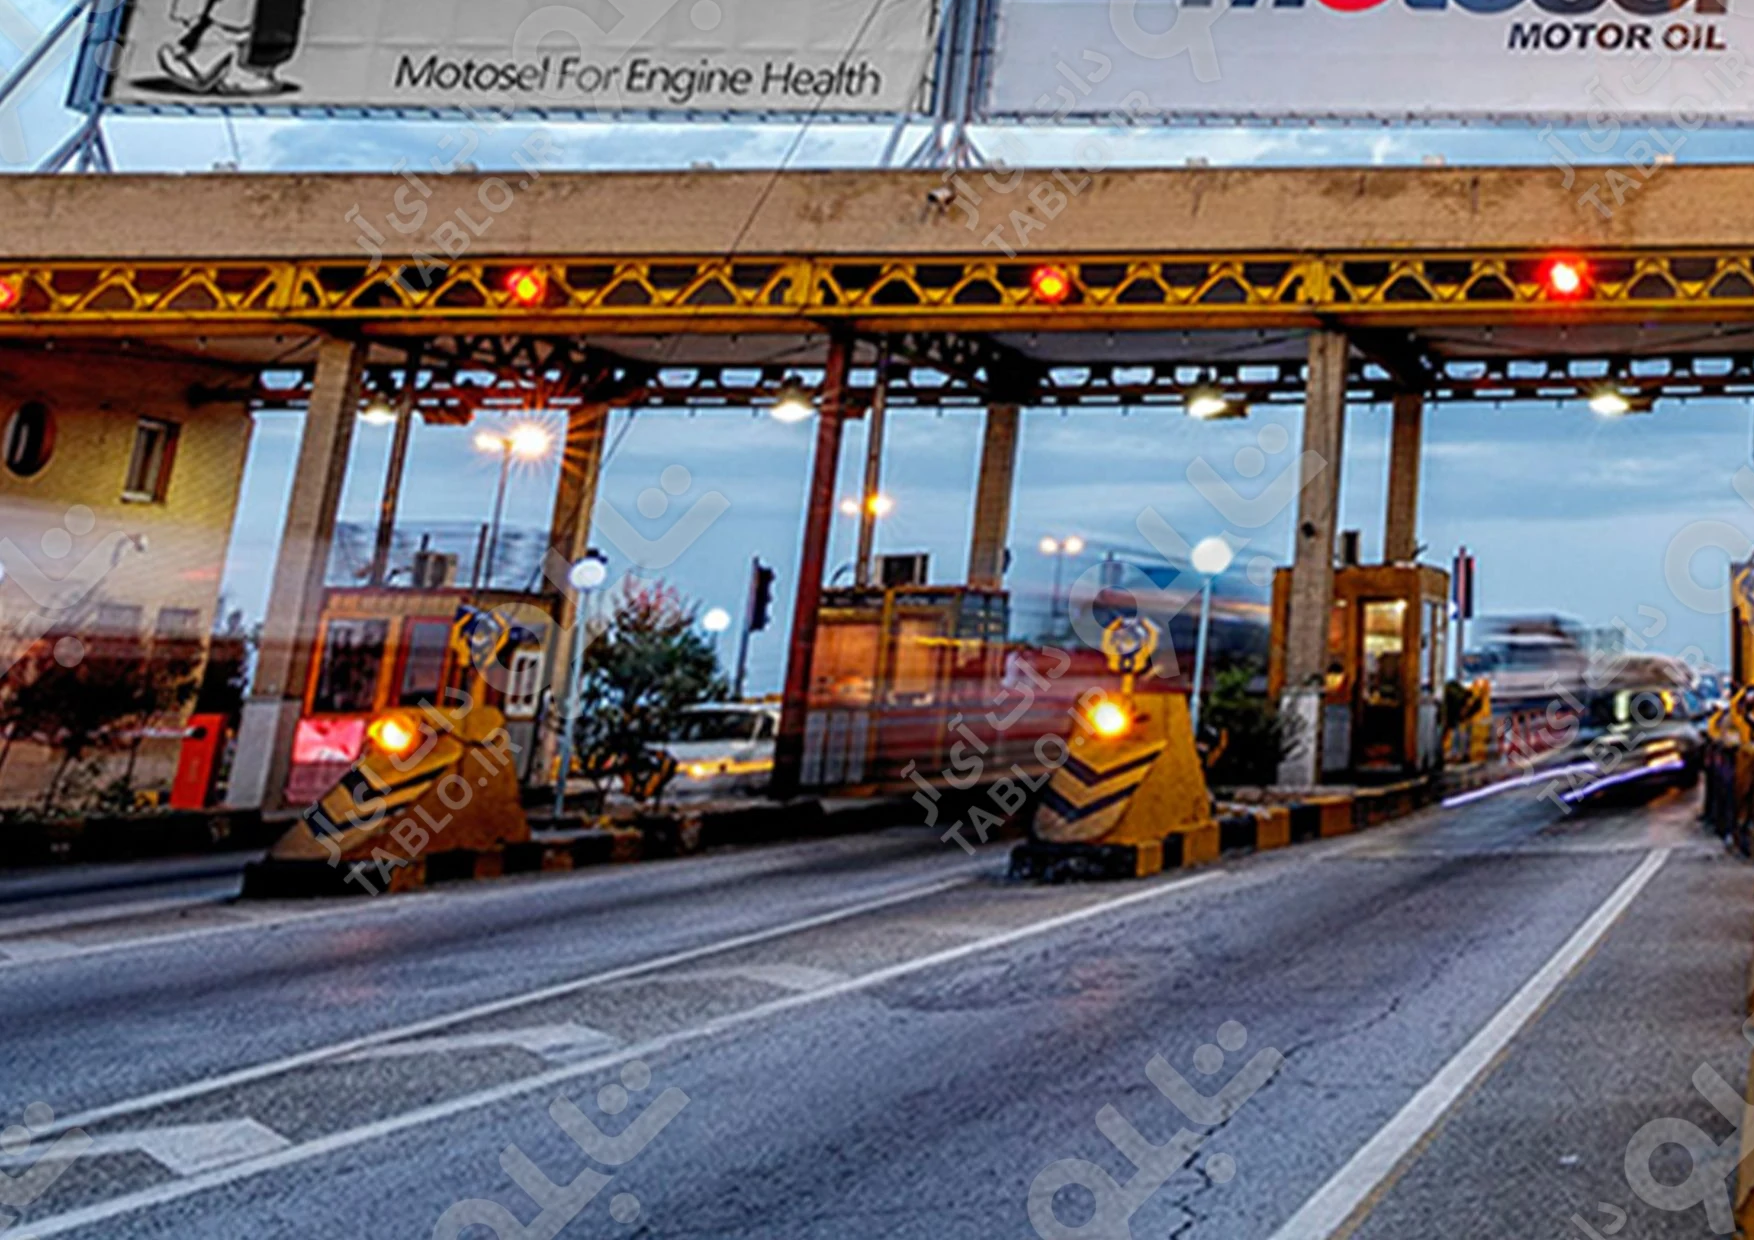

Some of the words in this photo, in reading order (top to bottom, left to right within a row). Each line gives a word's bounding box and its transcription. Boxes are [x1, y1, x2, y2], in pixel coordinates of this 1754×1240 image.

[1507, 22, 1652, 51] MOTOR
[1661, 22, 1728, 51] OIL
[395, 55, 550, 91] Motosel
[556, 57, 621, 92] For
[625, 58, 754, 104] Engine
[761, 61, 882, 97] Health
